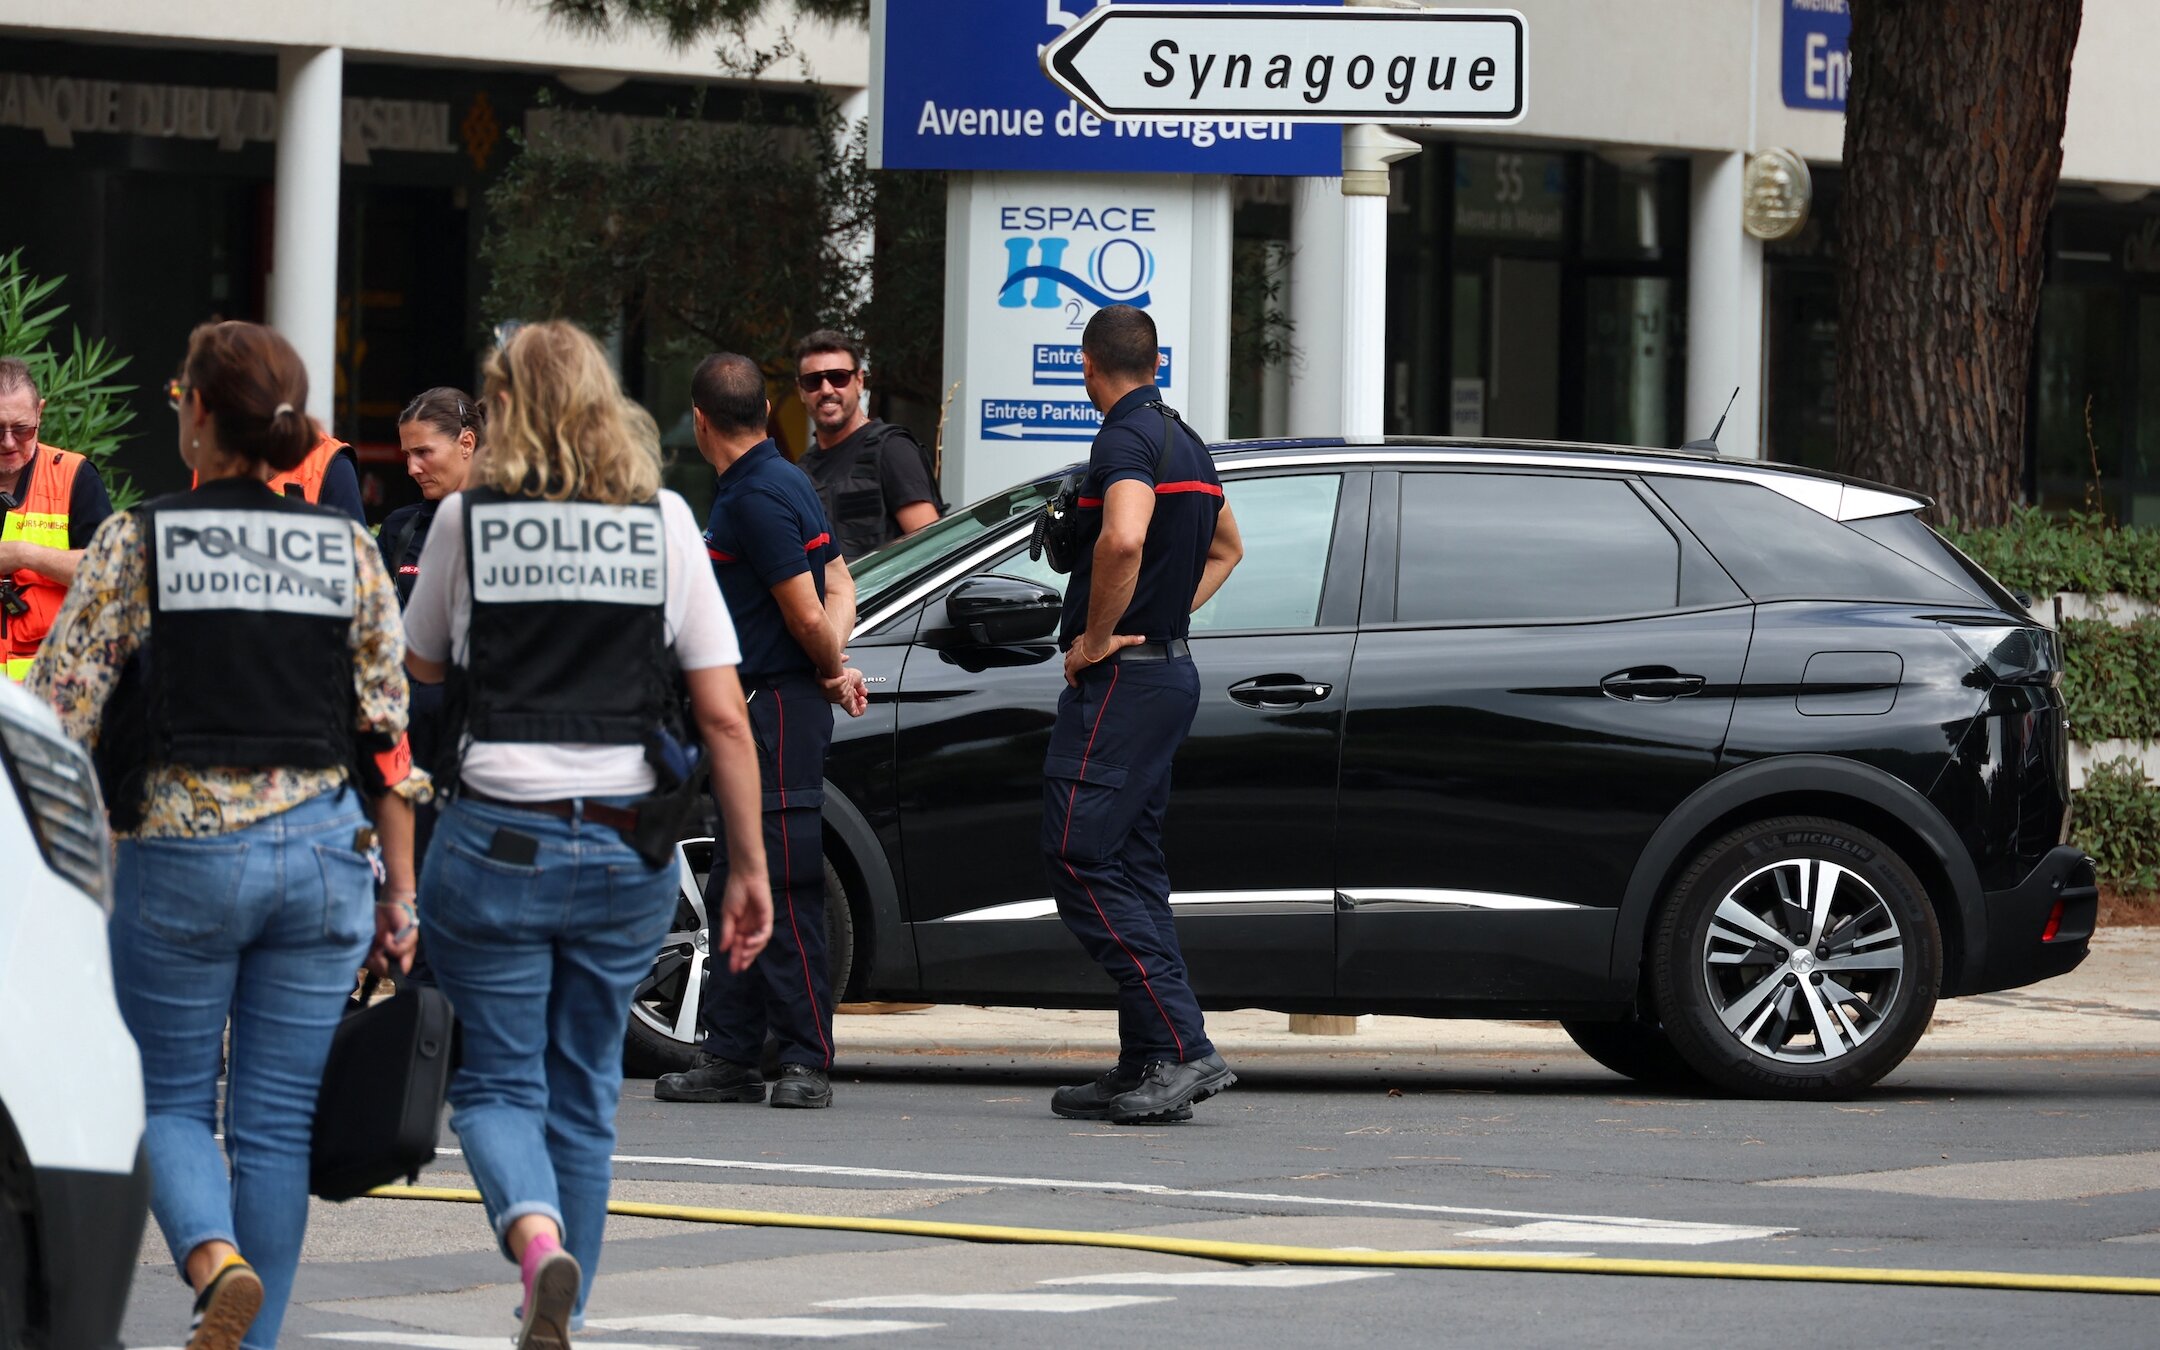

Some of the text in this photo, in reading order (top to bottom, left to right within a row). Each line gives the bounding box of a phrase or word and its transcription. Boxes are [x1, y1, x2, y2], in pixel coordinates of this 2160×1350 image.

[1143, 39, 1497, 104] Synagogue
[0, 74, 122, 149] ANQUE
[916, 99, 1044, 137] Avenue
[1054, 98, 1102, 138] de
[1001, 206, 1156, 232] ESPACE
[1036, 347, 1084, 365] Entré
[984, 402, 1106, 426] Entrée Parking
[164, 525, 346, 566] POLICE
[480, 517, 657, 555] POLICE
[482, 565, 659, 591] JUDICIAIRE
[1787, 832, 1873, 861] MICHELIN
